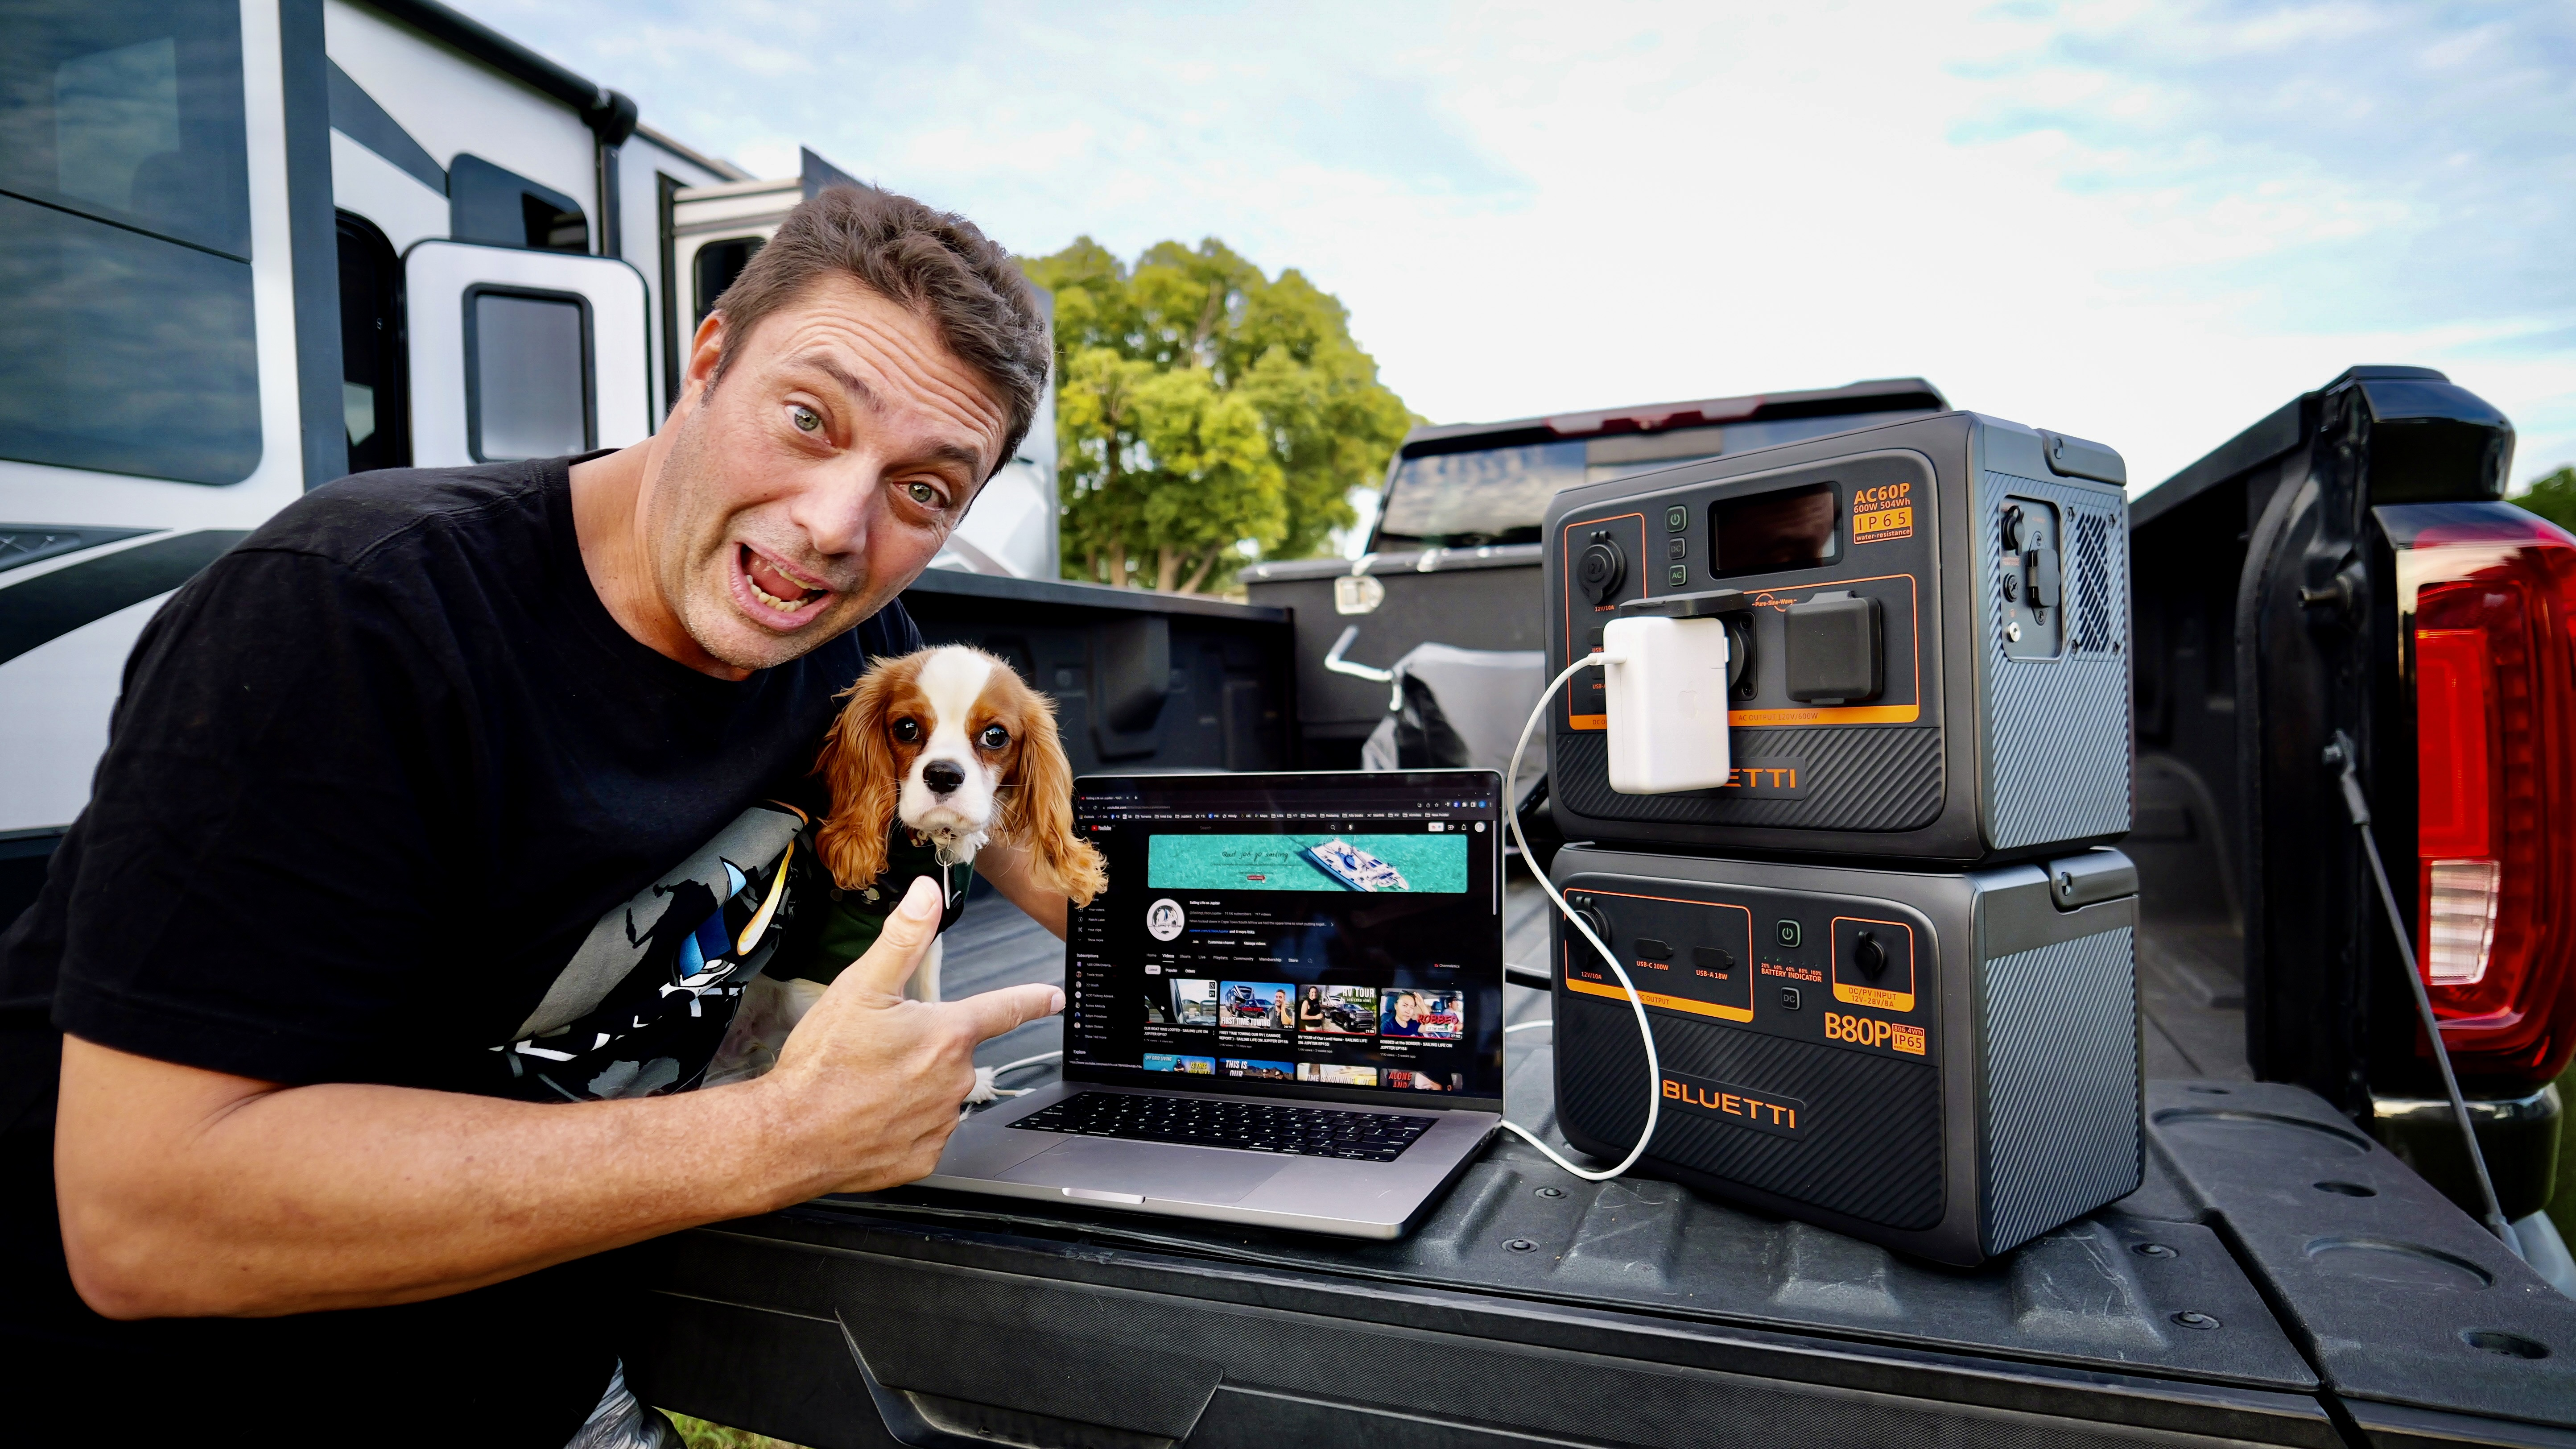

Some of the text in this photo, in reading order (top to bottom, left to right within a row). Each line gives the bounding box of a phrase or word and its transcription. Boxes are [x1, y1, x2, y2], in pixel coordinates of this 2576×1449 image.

[1854, 483, 1910, 505] AC60P
[1854, 497, 1910, 513] 600W 504Wh
[1856, 529, 1910, 541] water-resistance
[1723, 769, 1796, 788] ETTI
[1254, 852, 1262, 862] go
[1266, 851, 1288, 862] sailing
[1654, 962, 1668, 971] 100W
[1581, 972, 1602, 980] 12V/10A
[1696, 970, 1713, 978] USB-A
[1762, 968, 1822, 982] BATTERY INDICATOR
[1343, 988, 1375, 998] RV TOUR
[1849, 987, 1896, 1000] DC/PV INPUT
[1647, 996, 1669, 1005] OUTPUT
[1852, 995, 1894, 1007] 12V-28V/8A
[1417, 1014, 1458, 1024] ROBBED
[1825, 1012, 1891, 1047] B80P
[1894, 1026, 1922, 1035] 806.4Wh
[1895, 1034, 1921, 1048] IP65
[1226, 1060, 1239, 1068] THIS
[1327, 1076, 1355, 1085] RUNNING
[1389, 1072, 1412, 1081] ALONE
[1663, 1080, 1796, 1129] BLUETTI
